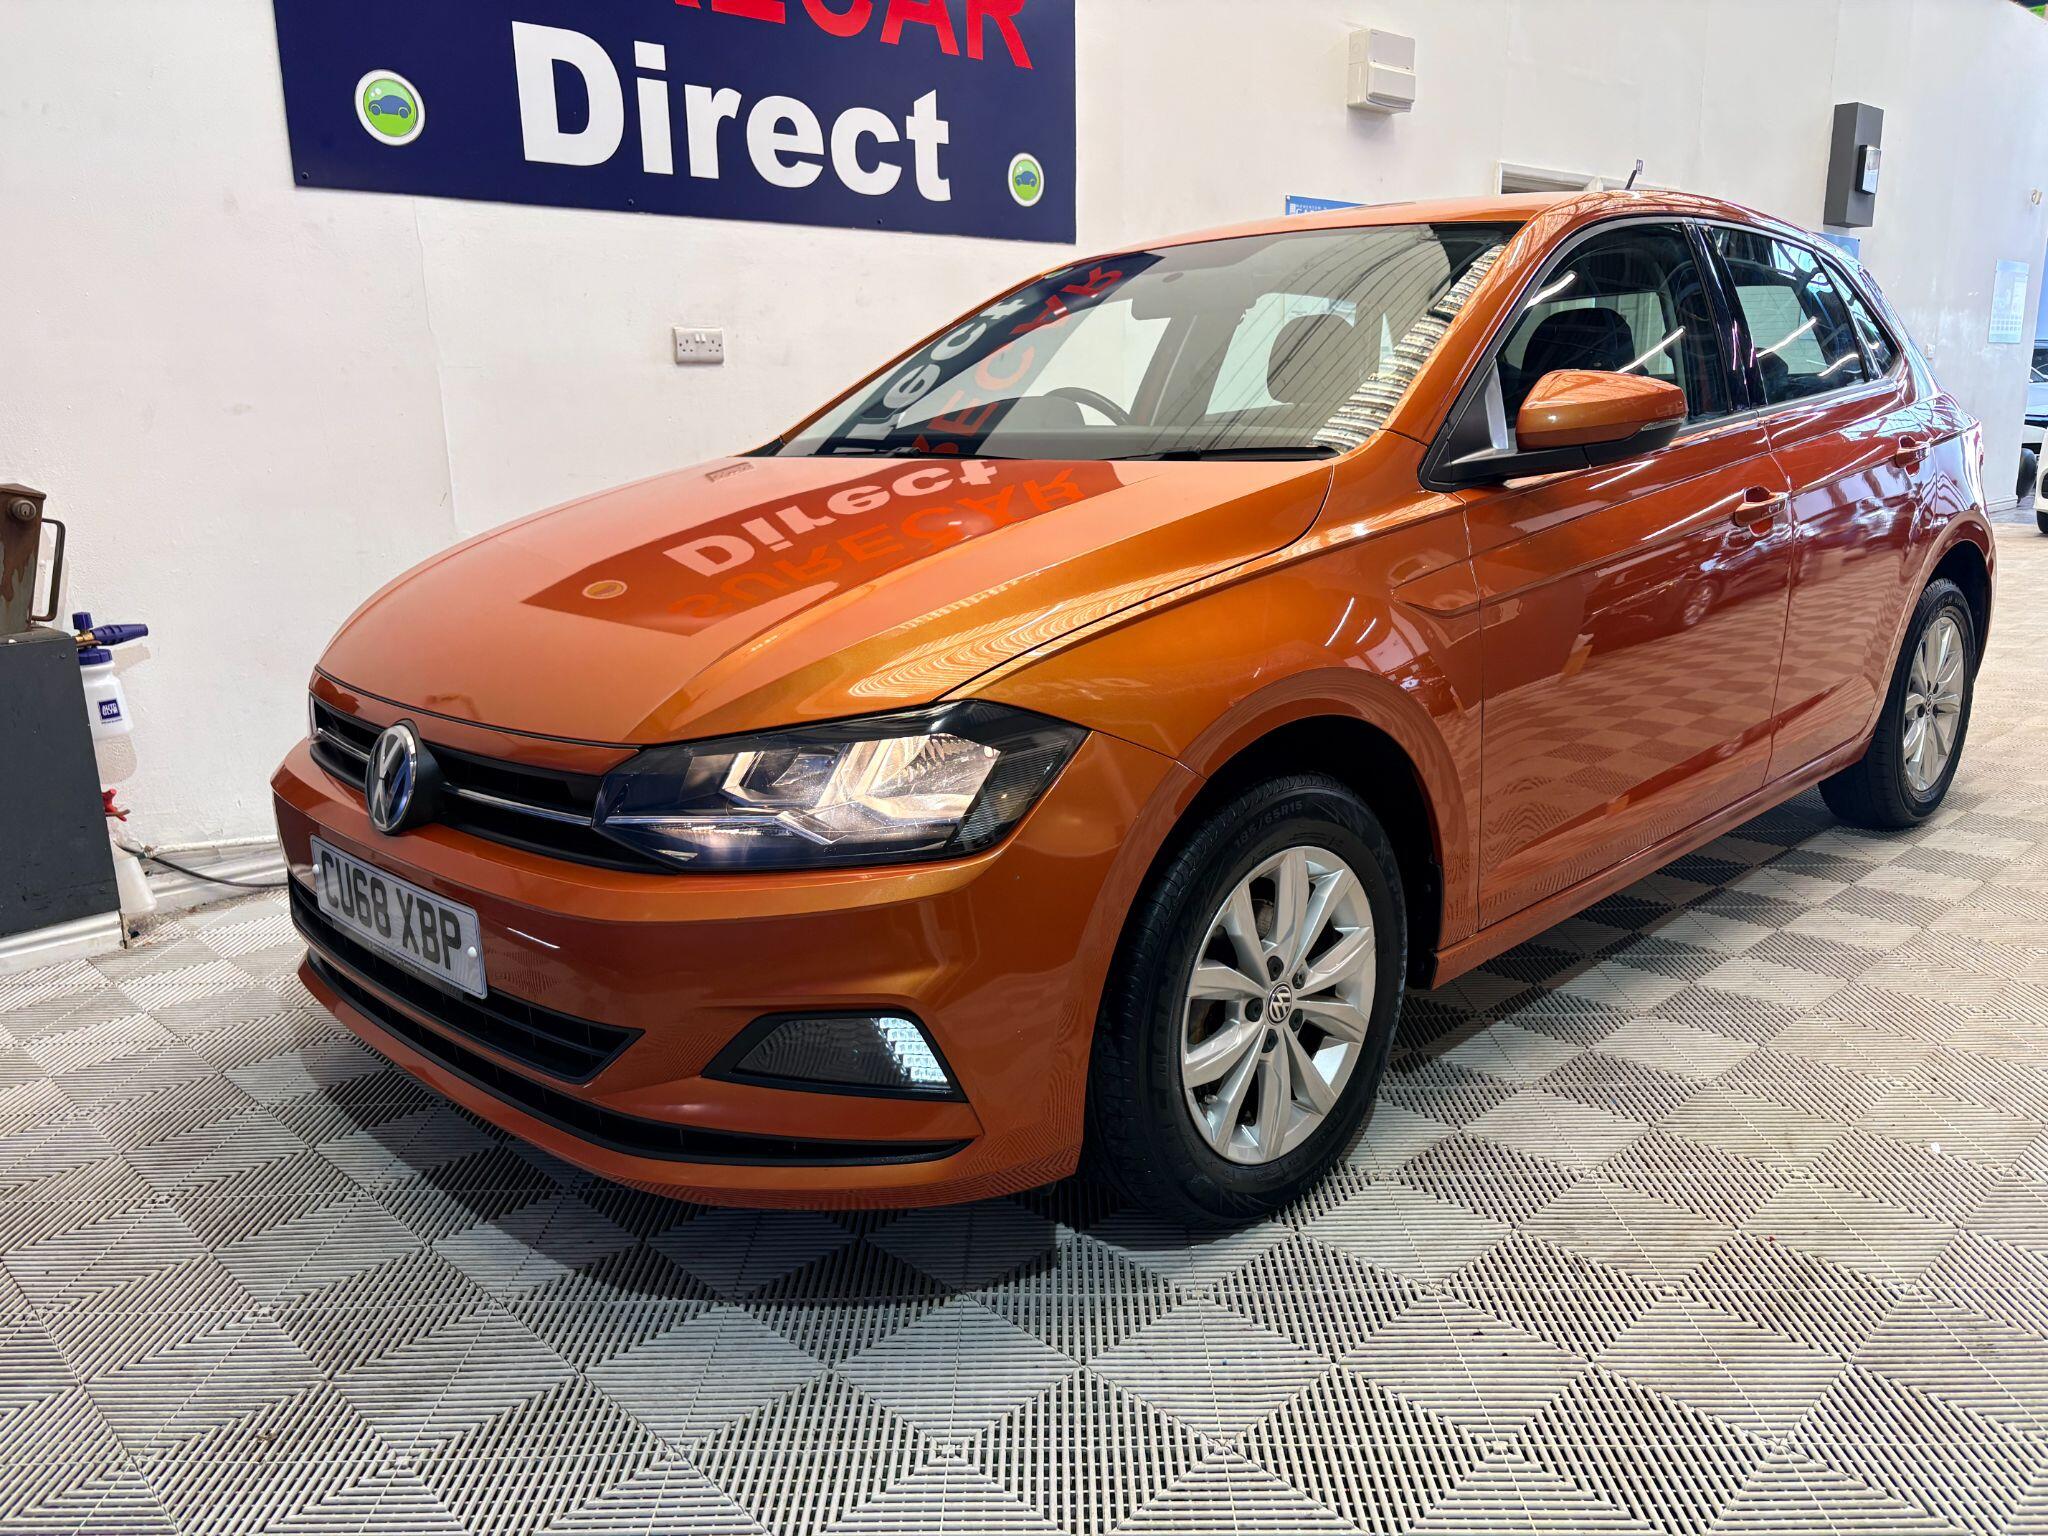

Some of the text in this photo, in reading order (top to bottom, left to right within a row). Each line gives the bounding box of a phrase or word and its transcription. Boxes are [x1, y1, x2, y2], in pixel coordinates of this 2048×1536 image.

[512, 21, 951, 202] Direct
[321, 850, 462, 970] CU68 XBP
